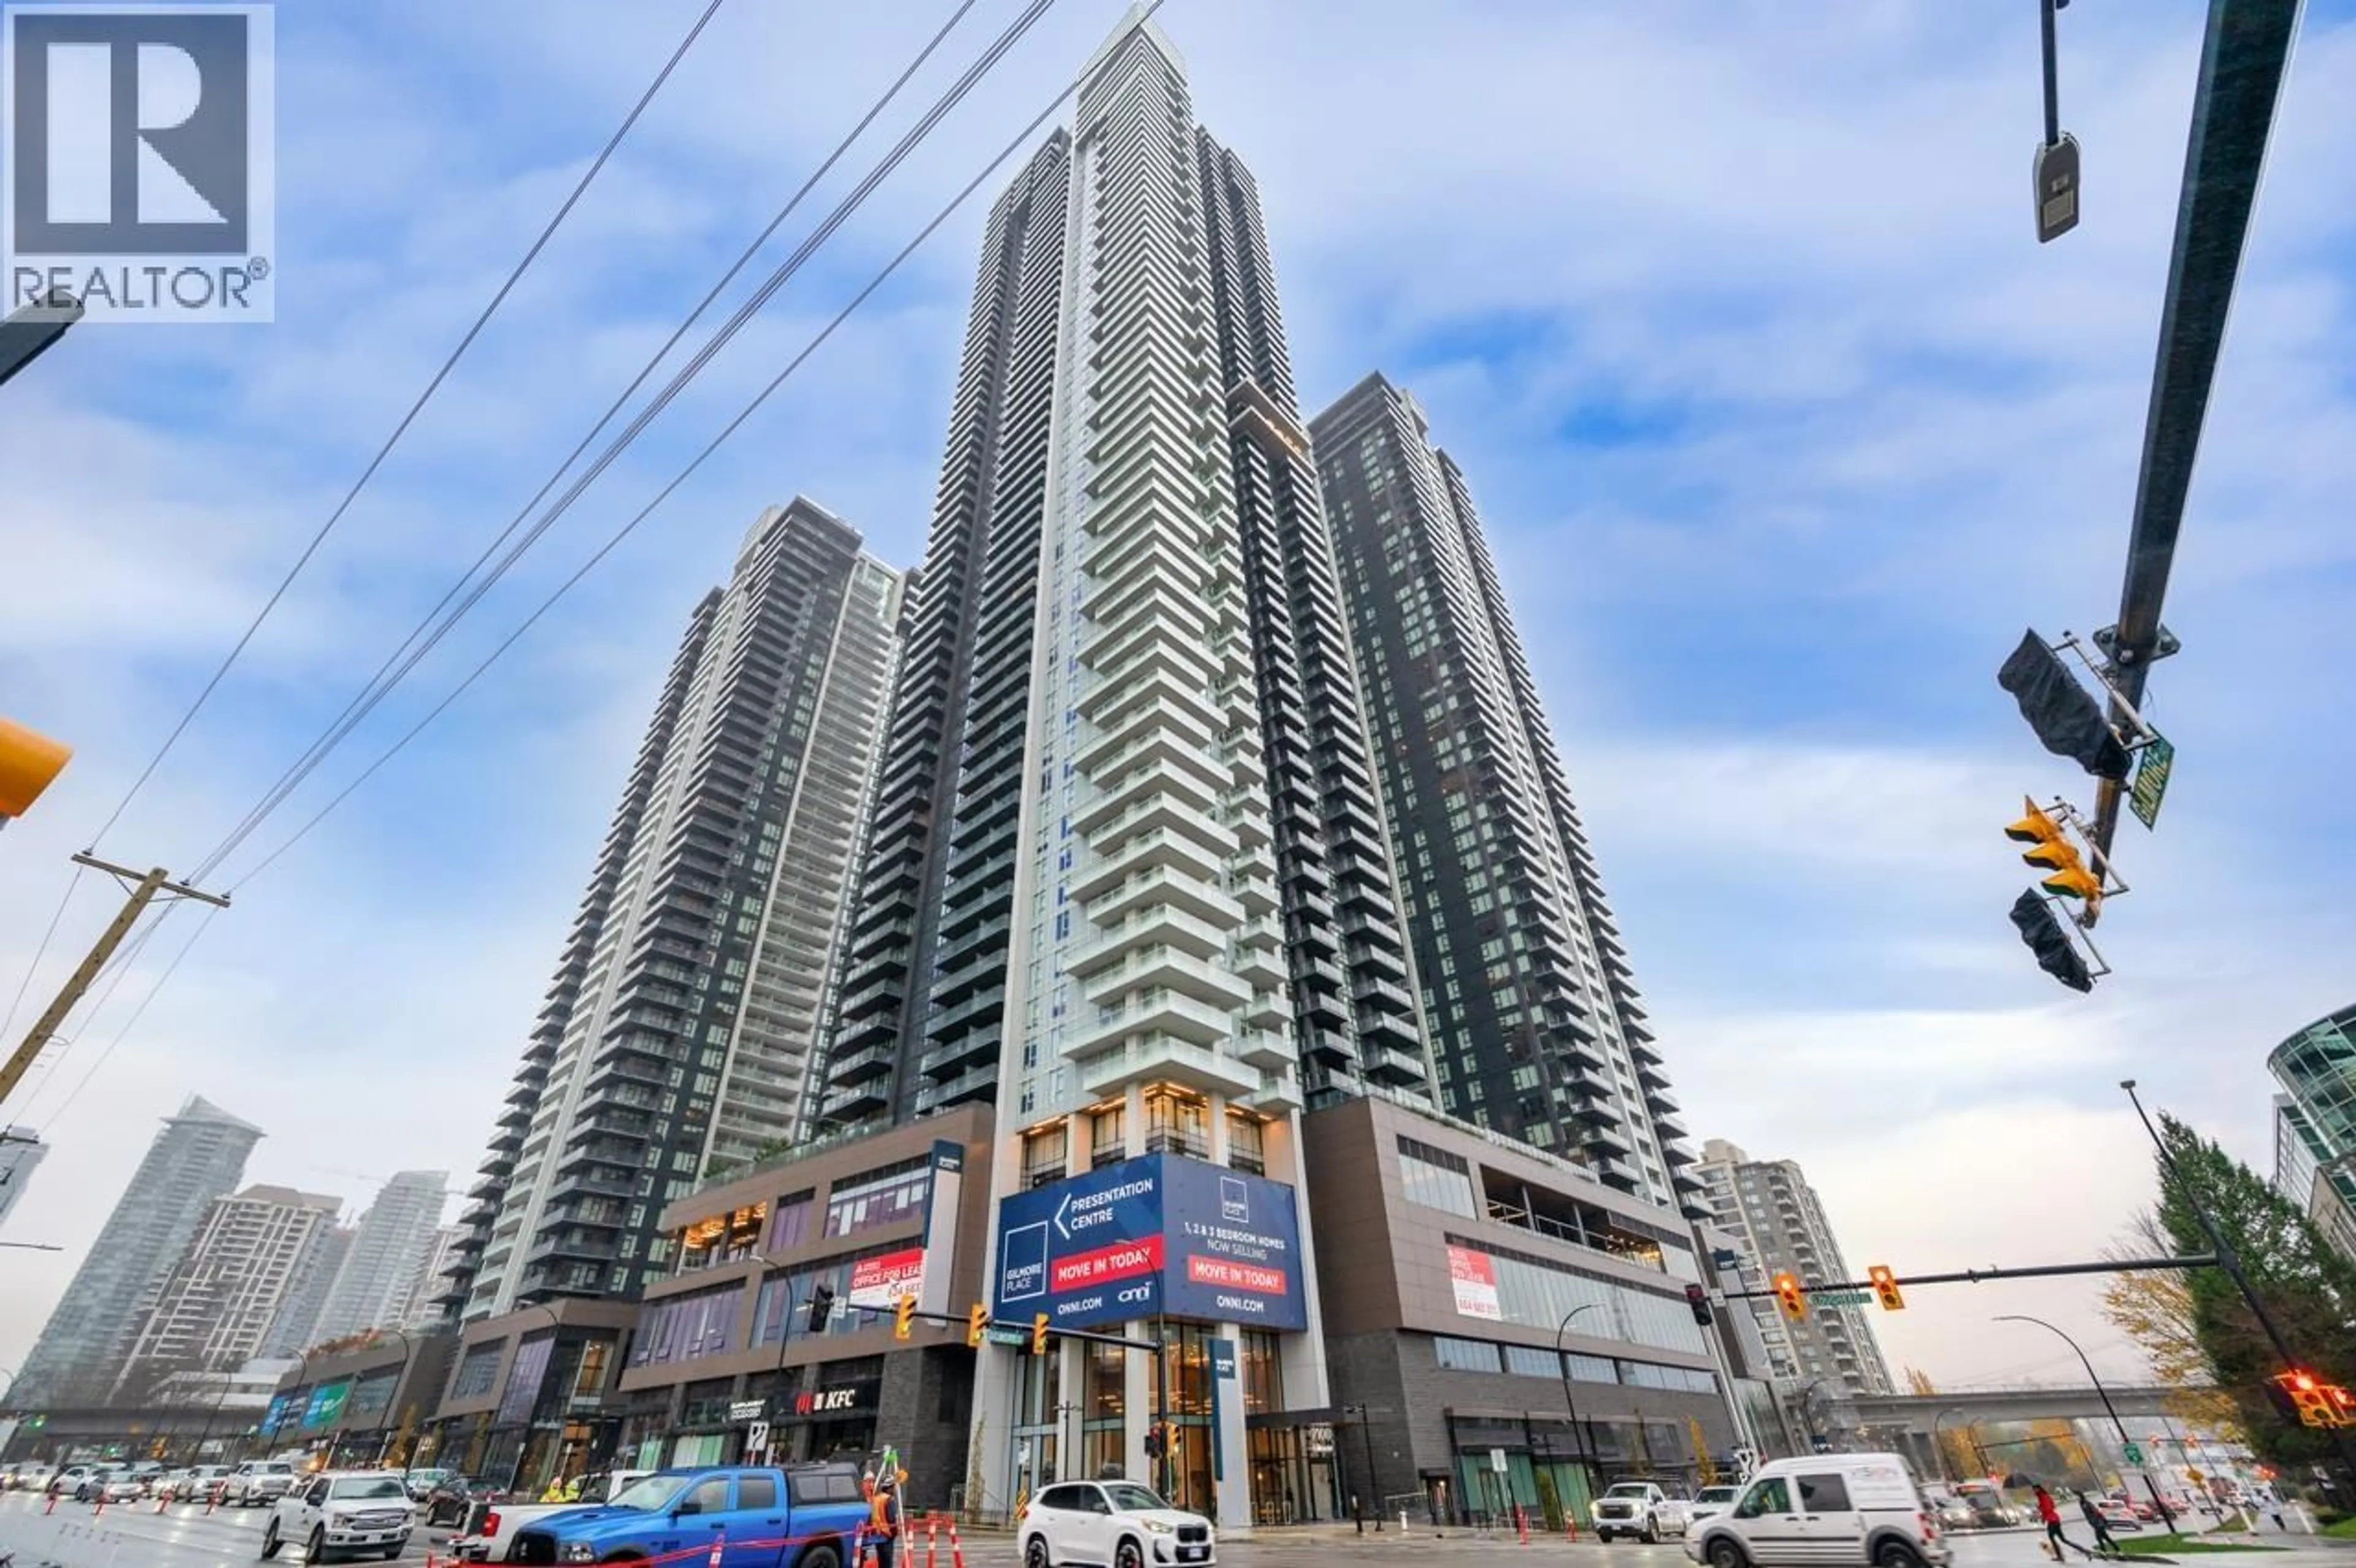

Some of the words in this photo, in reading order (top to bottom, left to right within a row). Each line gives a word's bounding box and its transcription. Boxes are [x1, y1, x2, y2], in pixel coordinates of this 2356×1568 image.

[2131, 744, 2168, 824] GILMORE
[1071, 1178, 1153, 1213] PRESENTATION
[1071, 1207, 1114, 1231] CENTRE
[1207, 1239, 1230, 1253] NOW
[1232, 1243, 1268, 1261] SELLING
[1217, 1228, 1257, 1245] BEDROOM
[1259, 1236, 1286, 1250] HOMES
[1007, 1262, 1042, 1280] GILMORE
[1058, 1261, 1091, 1282] MOVE
[1093, 1258, 1107, 1274] IN
[1109, 1247, 1151, 1270] TODAY
[1195, 1261, 1227, 1280] MOVE
[1230, 1267, 1242, 1282] IN
[1244, 1269, 1279, 1289] TODAY
[1007, 1277, 1031, 1293] PLACE
[1058, 1296, 1102, 1315] ONNI.COM
[1217, 1295, 1264, 1313] ONNI.COM
[825, 1389, 855, 1409] KFC
